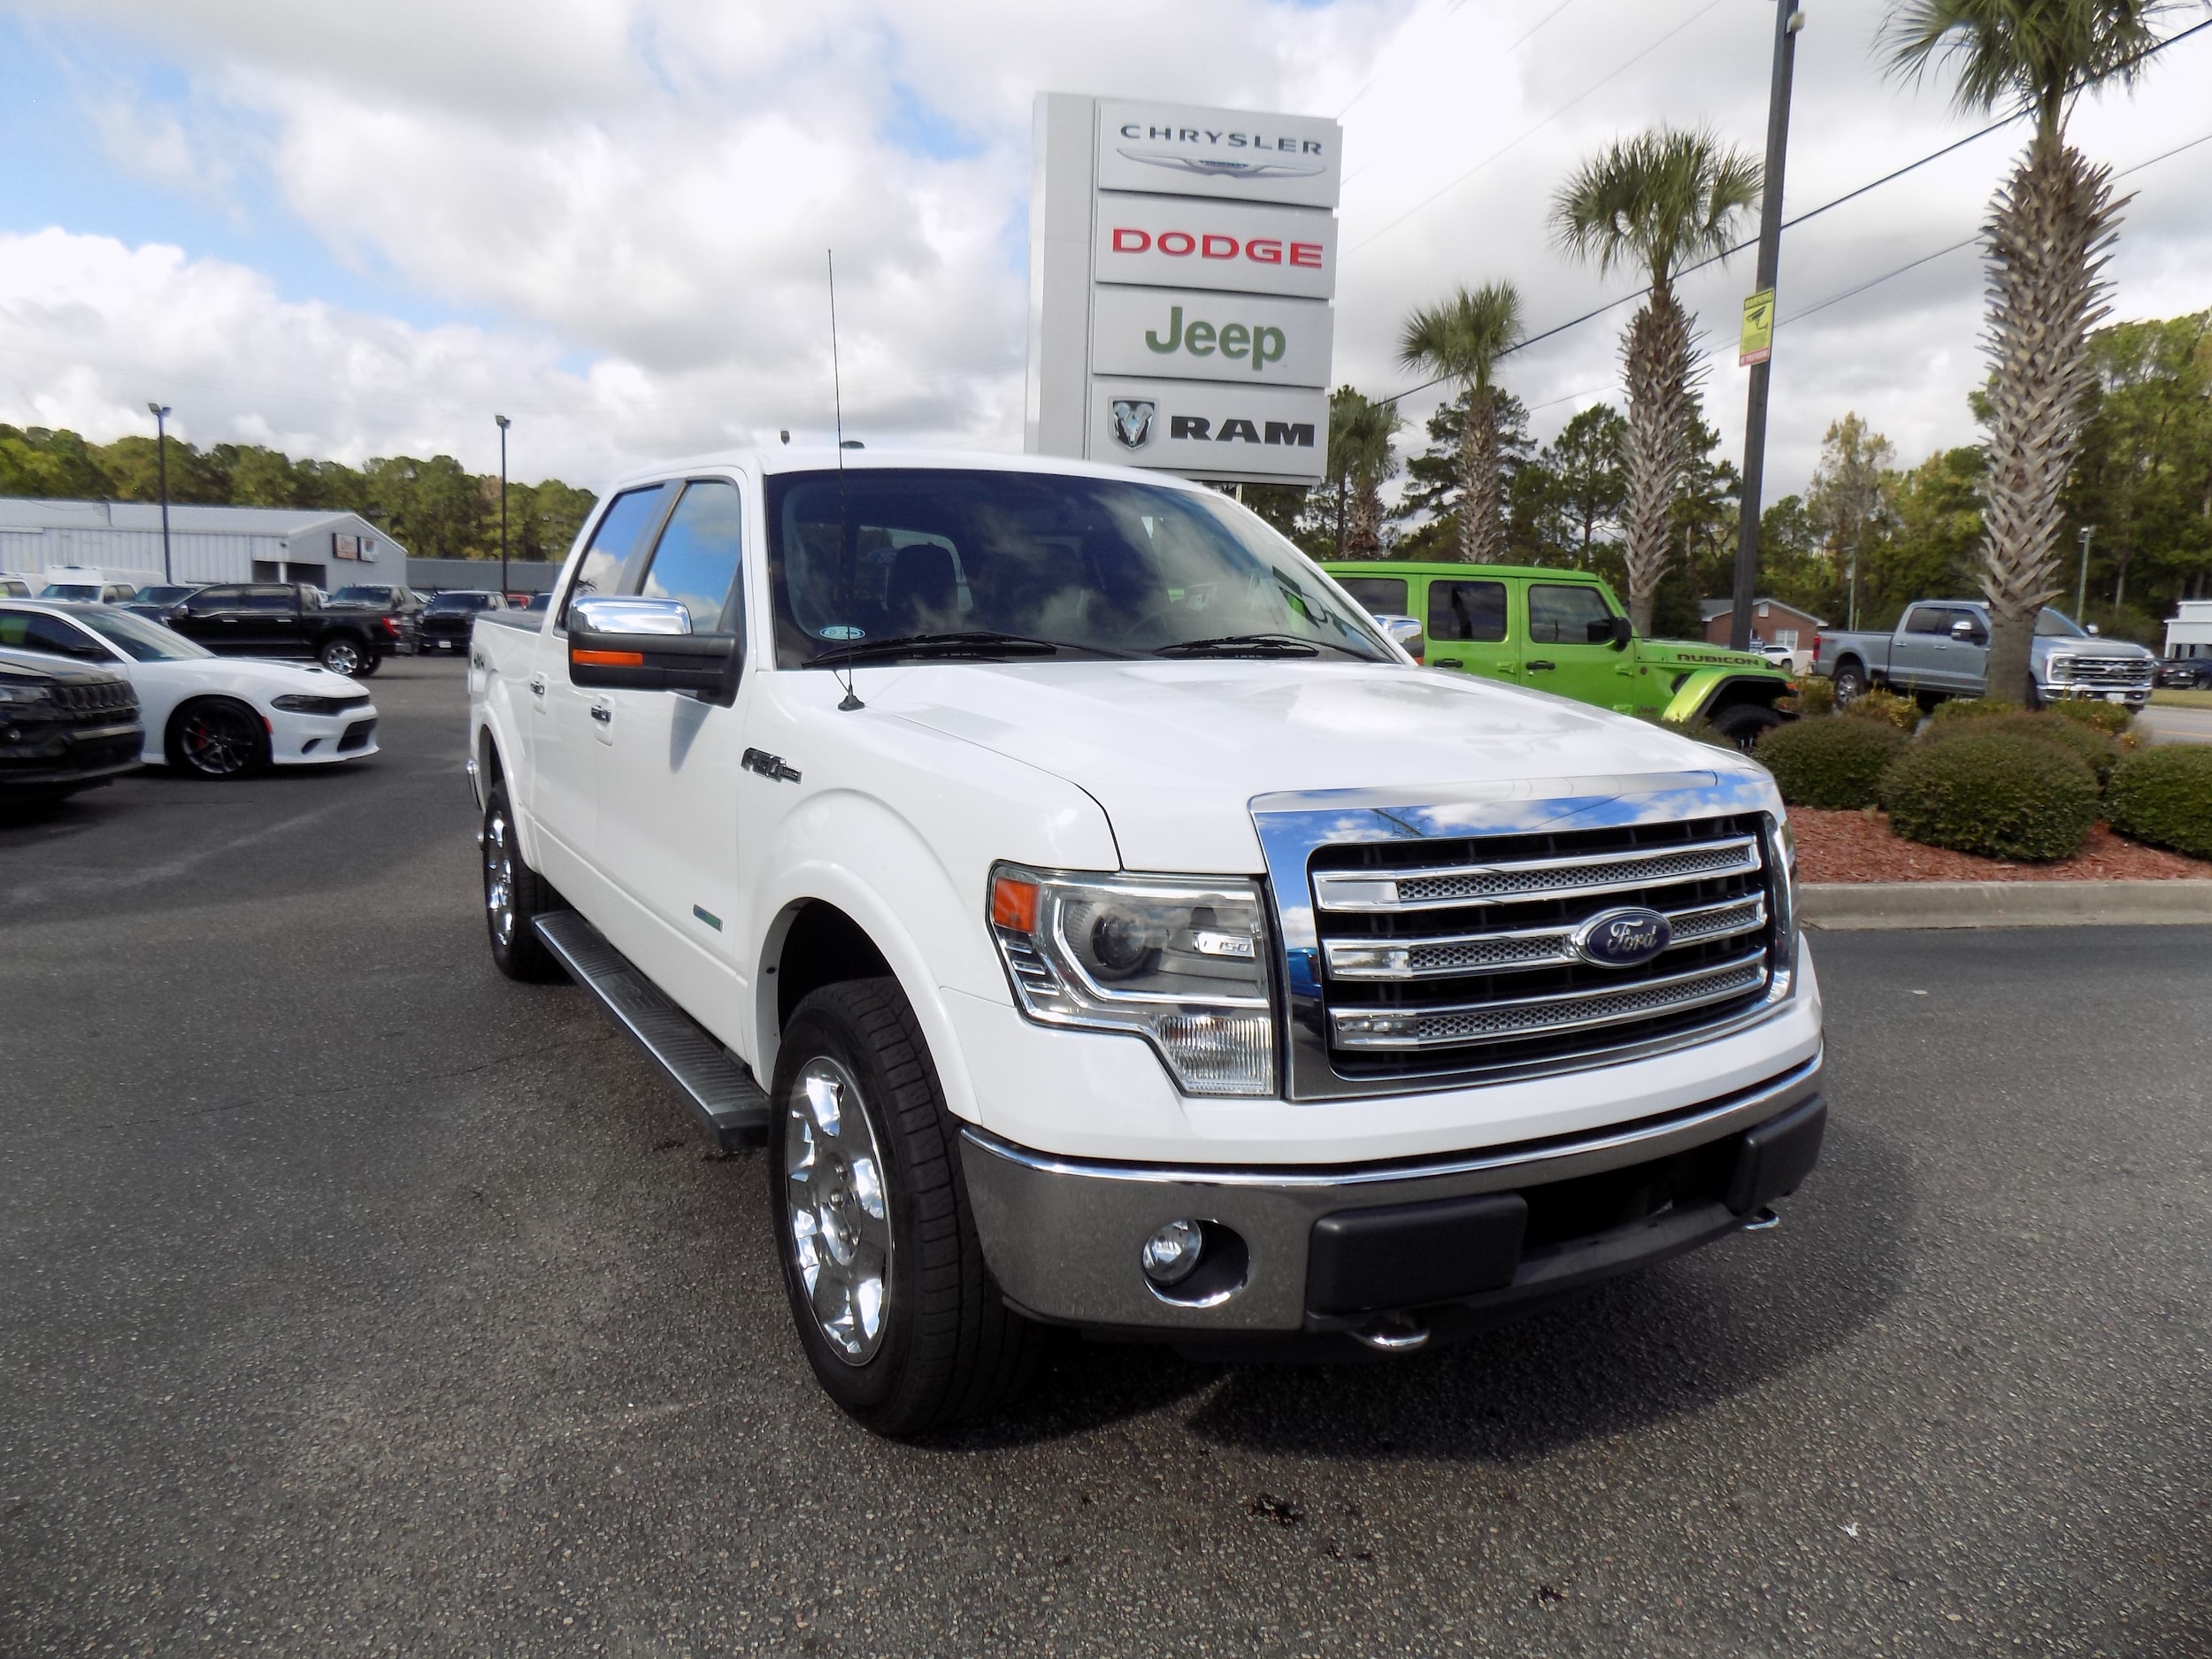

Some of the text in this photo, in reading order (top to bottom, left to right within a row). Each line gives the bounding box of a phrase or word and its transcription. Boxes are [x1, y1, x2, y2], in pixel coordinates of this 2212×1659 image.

[1119, 124, 1323, 157] CHRYSLER
[1112, 228, 1324, 270] DODGE
[1145, 306, 1286, 372] Jeep
[1170, 415, 1316, 449] RAM
[1677, 653, 1760, 666] RUBICON
[1607, 919, 1658, 956] Ford
